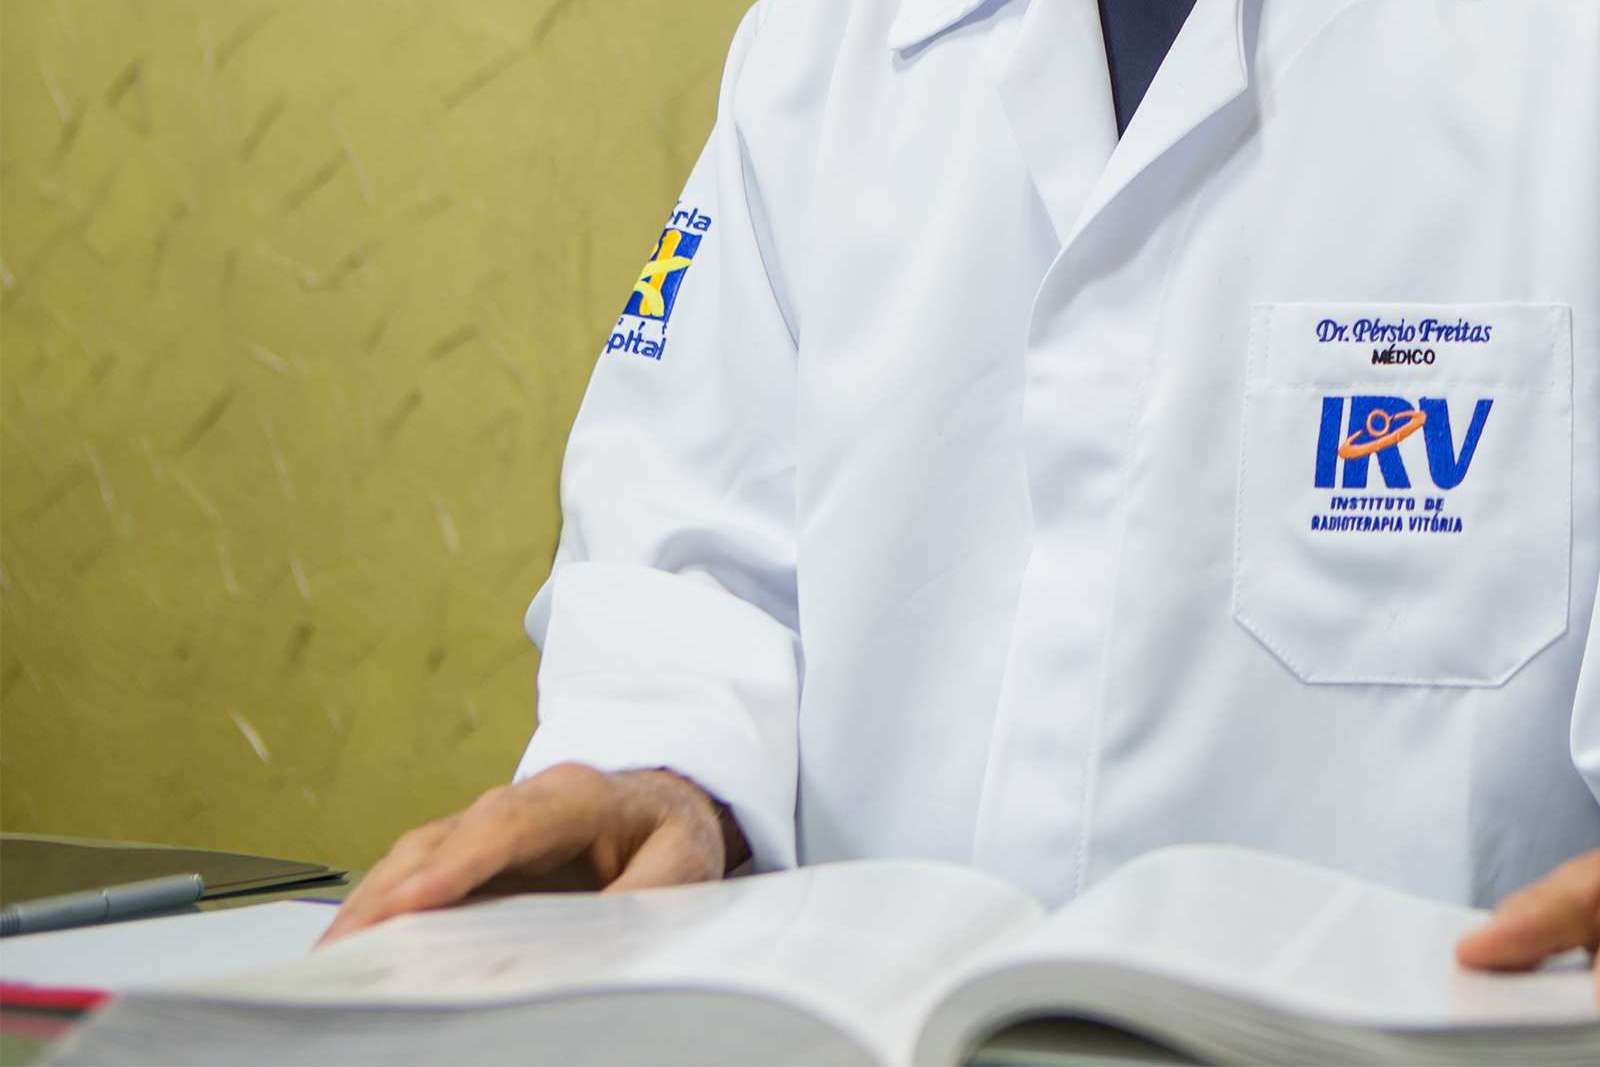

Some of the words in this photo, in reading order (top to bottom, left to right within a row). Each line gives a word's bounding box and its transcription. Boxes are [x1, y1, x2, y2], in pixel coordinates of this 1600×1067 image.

[671, 207, 712, 232] ria
[1316, 319, 1349, 343] Dr.
[1352, 318, 1416, 343] Pérsio
[1418, 318, 1492, 343] Freitas
[605, 330, 667, 360] pital
[1371, 344, 1435, 365] MÉDICO
[1314, 395, 1494, 490] IRV
[1330, 497, 1415, 511] INSTITUTO
[1424, 497, 1445, 511] DE
[1311, 515, 1403, 532] RADIOTERAPIA
[1408, 511, 1463, 533] VITÓRIA
